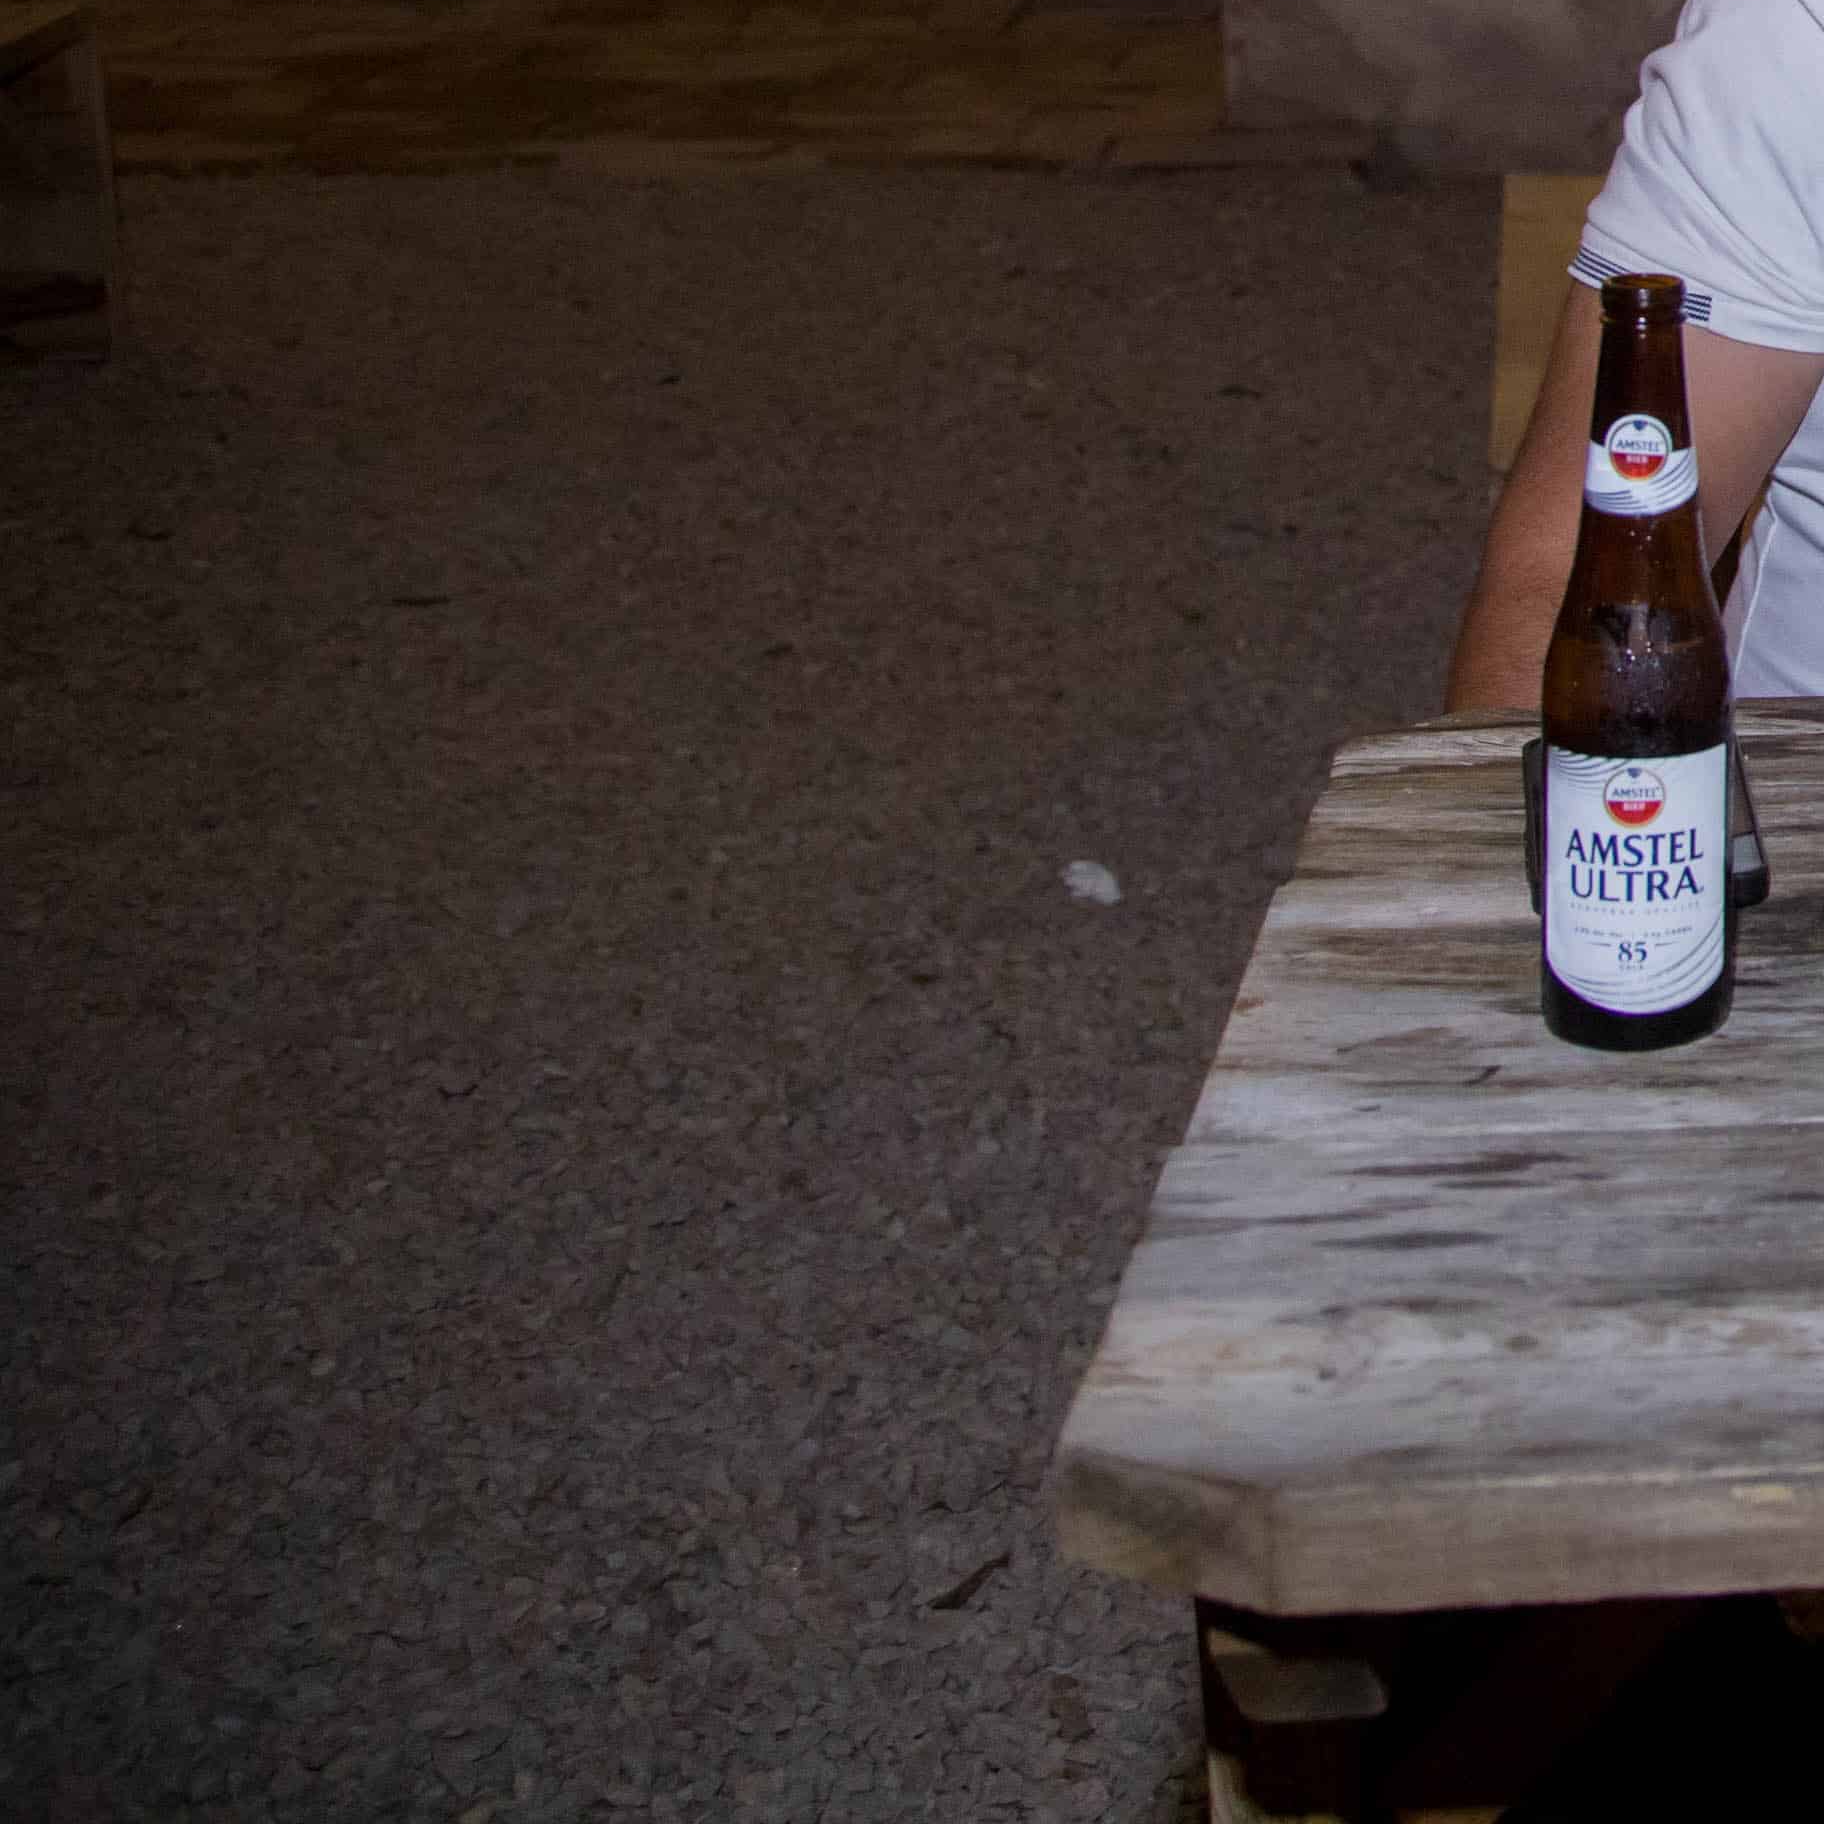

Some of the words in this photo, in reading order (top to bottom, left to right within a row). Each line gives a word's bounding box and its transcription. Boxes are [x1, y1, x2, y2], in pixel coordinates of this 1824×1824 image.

[1616, 439, 1660, 452] AMSTEL
[1612, 787, 1658, 798] AMSTEL
[1565, 828, 1704, 867] AMSTEL
[1571, 864, 1701, 903] ULTRA
[1618, 940, 1648, 962] 85
